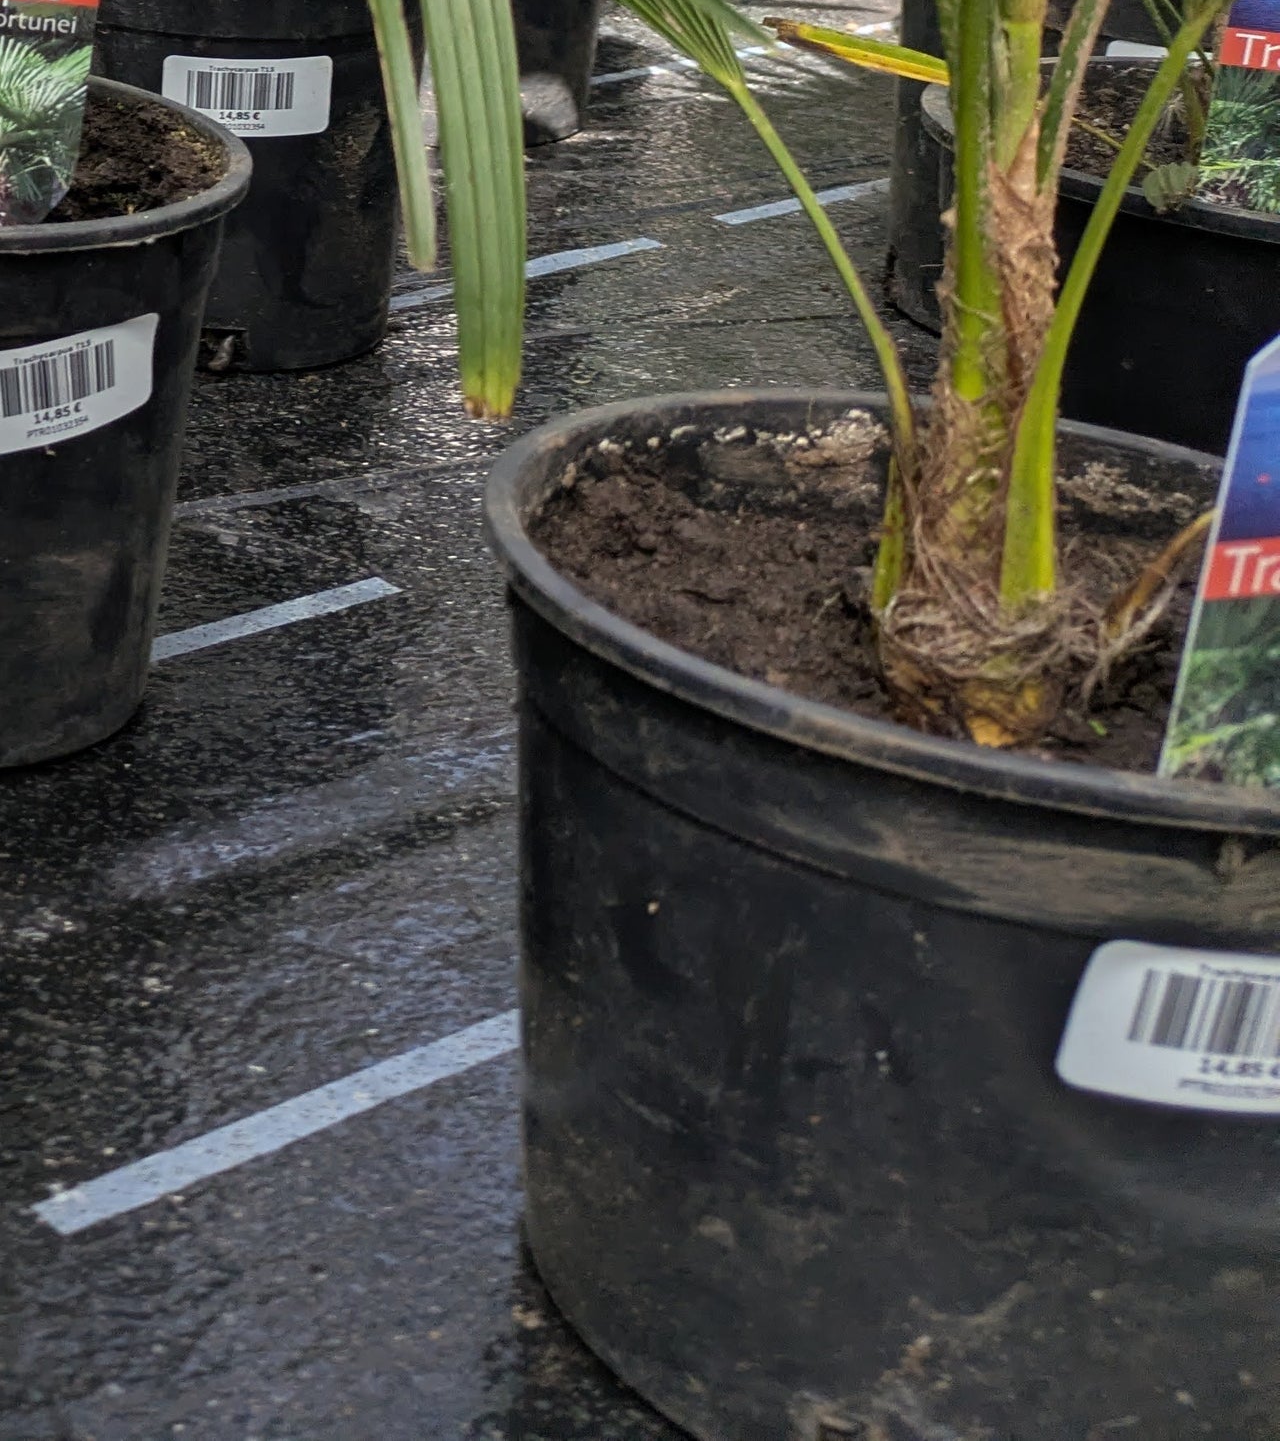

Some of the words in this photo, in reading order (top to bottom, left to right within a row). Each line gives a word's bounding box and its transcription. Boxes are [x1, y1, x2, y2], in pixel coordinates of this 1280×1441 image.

[218, 111, 251, 122] 14,85
[253, 111, 262, 121] €
[33, 408, 71, 426] 14,85
[73, 401, 84, 414] €
[1223, 545, 1280, 595] Tr
